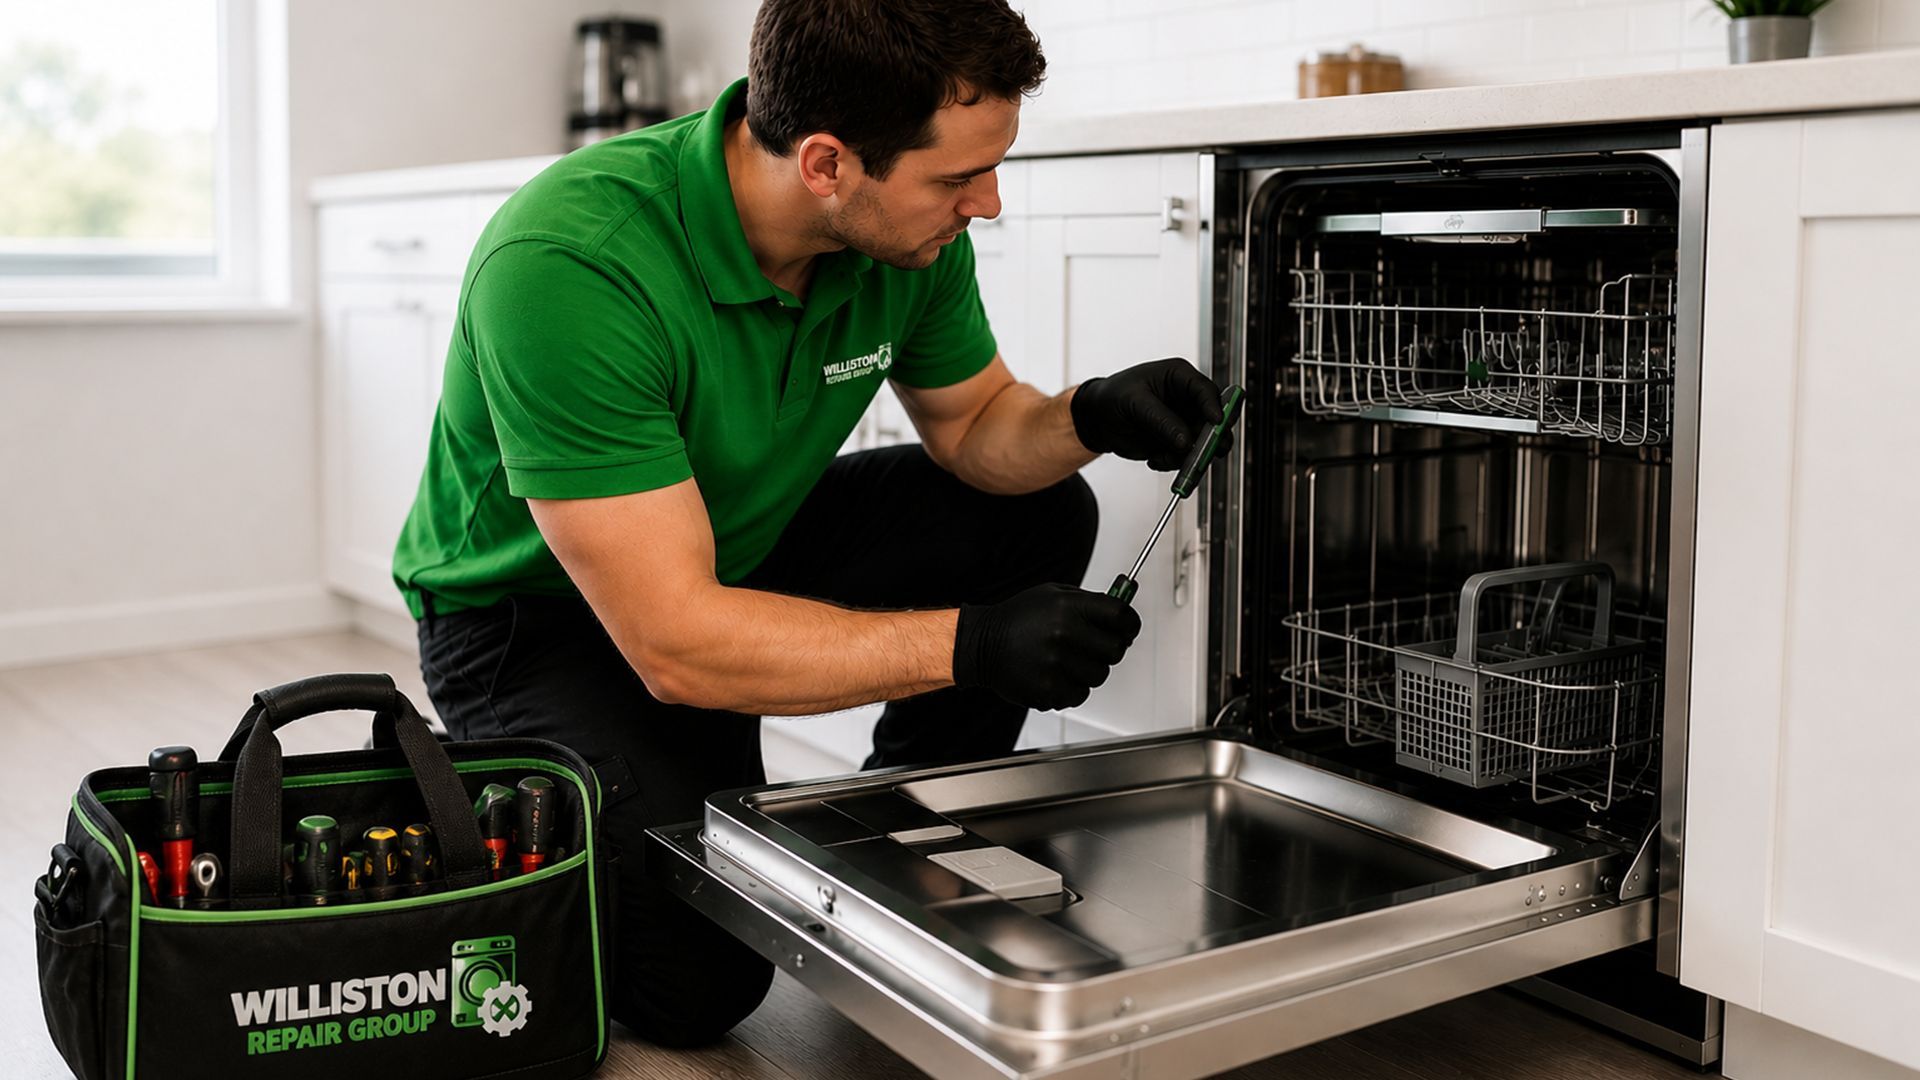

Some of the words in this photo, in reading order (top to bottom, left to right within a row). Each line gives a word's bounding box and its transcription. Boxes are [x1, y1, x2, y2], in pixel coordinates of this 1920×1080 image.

[231, 968, 446, 1027] WILLISTON
[247, 1022, 342, 1055] REPAIR
[348, 1009, 436, 1041] GROUP
